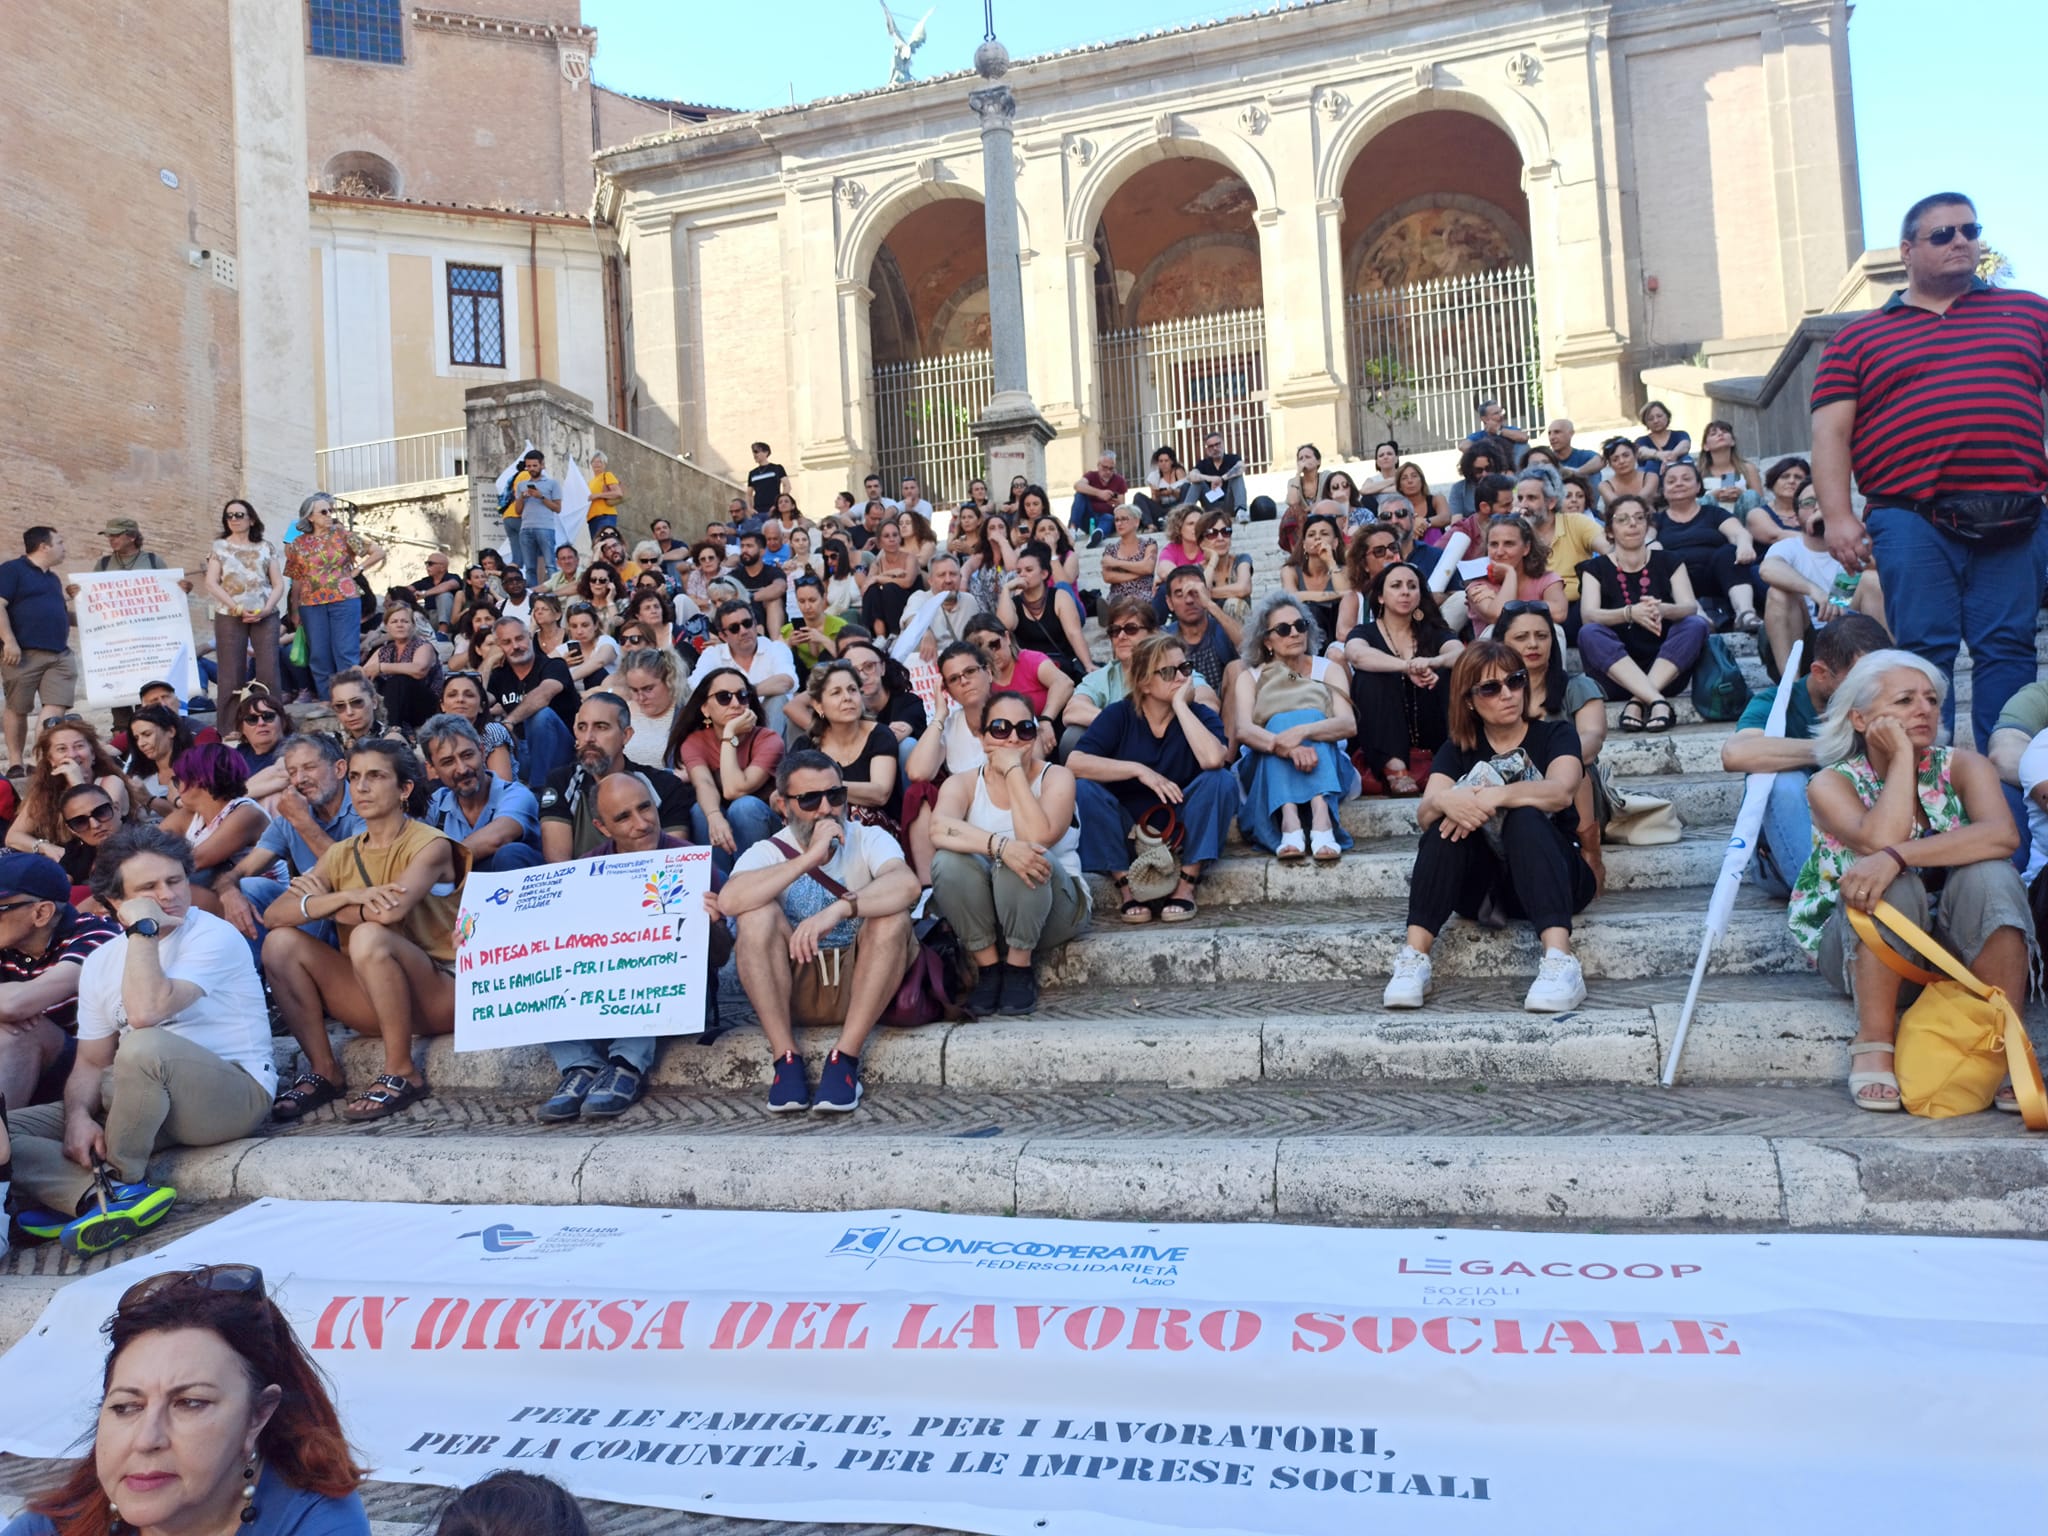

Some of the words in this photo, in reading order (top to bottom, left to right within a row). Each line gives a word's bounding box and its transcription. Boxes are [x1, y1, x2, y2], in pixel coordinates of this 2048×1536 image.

[91, 576, 158, 592] ADEGUARE
[87, 593, 103, 603] LE
[88, 593, 171, 613] CONFERMARE
[112, 605, 161, 618] DIRITTI
[546, 866, 576, 880] LAZIO
[460, 952, 473, 974] IN
[480, 944, 529, 966] DIFESA
[531, 940, 550, 955] DEL
[554, 933, 608, 950] LAVORO
[472, 980, 490, 996] PER
[494, 978, 506, 991] LE
[509, 965, 562, 989] FAMIGLIE
[573, 960, 597, 975] PER
[600, 961, 604, 973] I
[608, 952, 678, 971] LAVORATORI
[472, 1005, 495, 1021] PER
[580, 989, 605, 1006] PER
[608, 988, 626, 1001] LE
[631, 984, 686, 1000] IMPRESE
[599, 1003, 660, 1015] SOCIALI
[898, 1236, 1189, 1262] CONFCOOPERATIVE
[976, 1258, 1178, 1277] FEDERSOLIDARIETÀ
[1398, 1257, 1702, 1280] LEGACOOP
[1132, 1276, 1176, 1287] LAZIO
[1422, 1286, 1520, 1296] SOCIALI
[1422, 1296, 1497, 1307] LAZIO
[311, 1296, 409, 1350] IN
[411, 1297, 690, 1351] DIFESA
[709, 1300, 869, 1350] DEL
[892, 1303, 1263, 1352] LAVORO
[1292, 1311, 1742, 1355] SOCIALE
[506, 1406, 600, 1426] PER
[603, 1409, 665, 1428] LE
[666, 1410, 893, 1439] FAMIGLIE,
[907, 1416, 1006, 1437] PER
[1017, 1418, 1041, 1437] I
[1051, 1419, 1396, 1460] LAVORATORI,
[404, 1432, 501, 1456] PER
[502, 1437, 562, 1459] LA
[569, 1438, 818, 1471] COMUNITÀ,
[834, 1448, 935, 1472] PER
[945, 1451, 1010, 1475] LE
[1018, 1453, 1255, 1487] IMPRESE
[1269, 1464, 1492, 1501] SOCIALI
